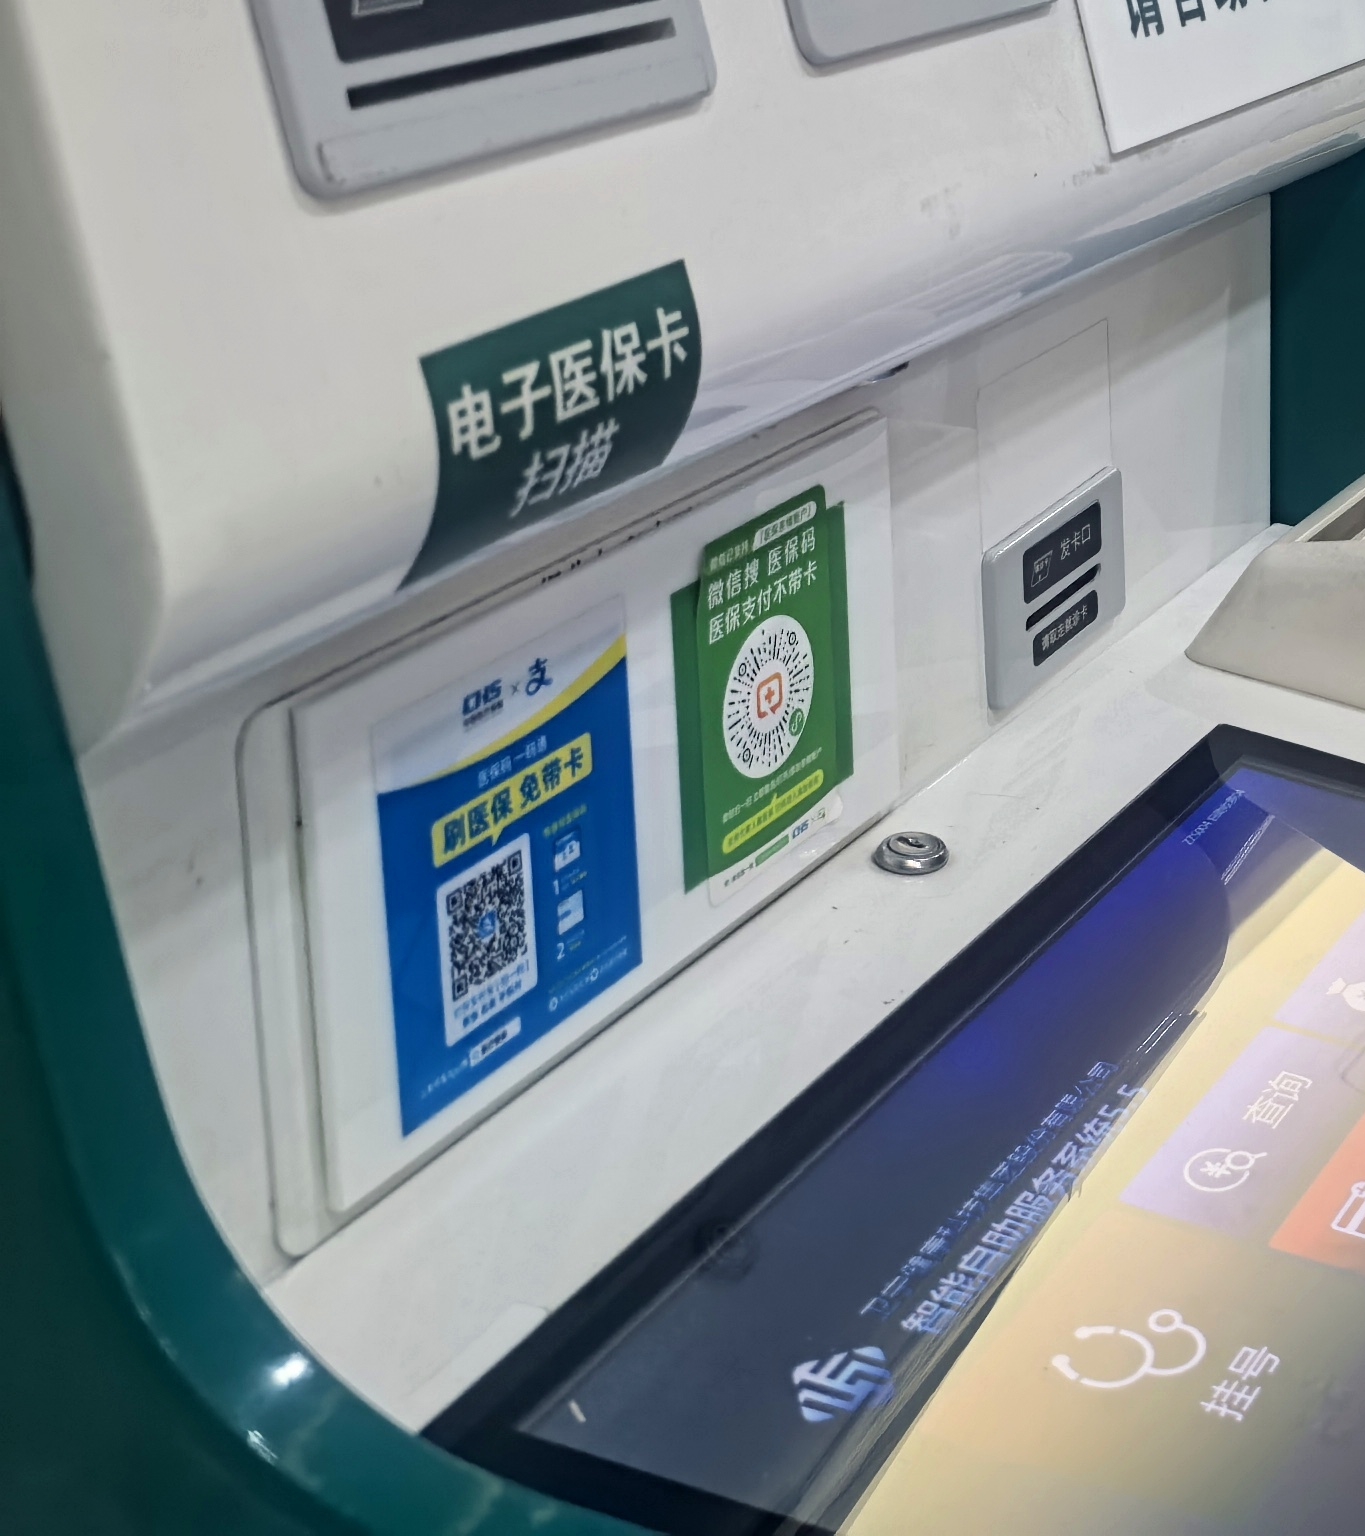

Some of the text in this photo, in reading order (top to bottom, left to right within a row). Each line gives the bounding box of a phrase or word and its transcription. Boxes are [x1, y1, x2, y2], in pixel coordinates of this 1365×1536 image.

[447, 307, 690, 461] 电子医保卡
[508, 418, 621, 518] 扫描
[707, 527, 817, 612] 微信搜 医保码
[1060, 523, 1092, 561] 发卡口
[708, 561, 818, 646] 医保支付不带卡
[442, 789, 515, 855] 刷医保
[520, 746, 585, 809] 免带卡
[1242, 1069, 1313, 1130] 查询
[901, 1083, 1149, 1335] 智能自助服务系统55
[1201, 1344, 1281, 1422] 挂号
